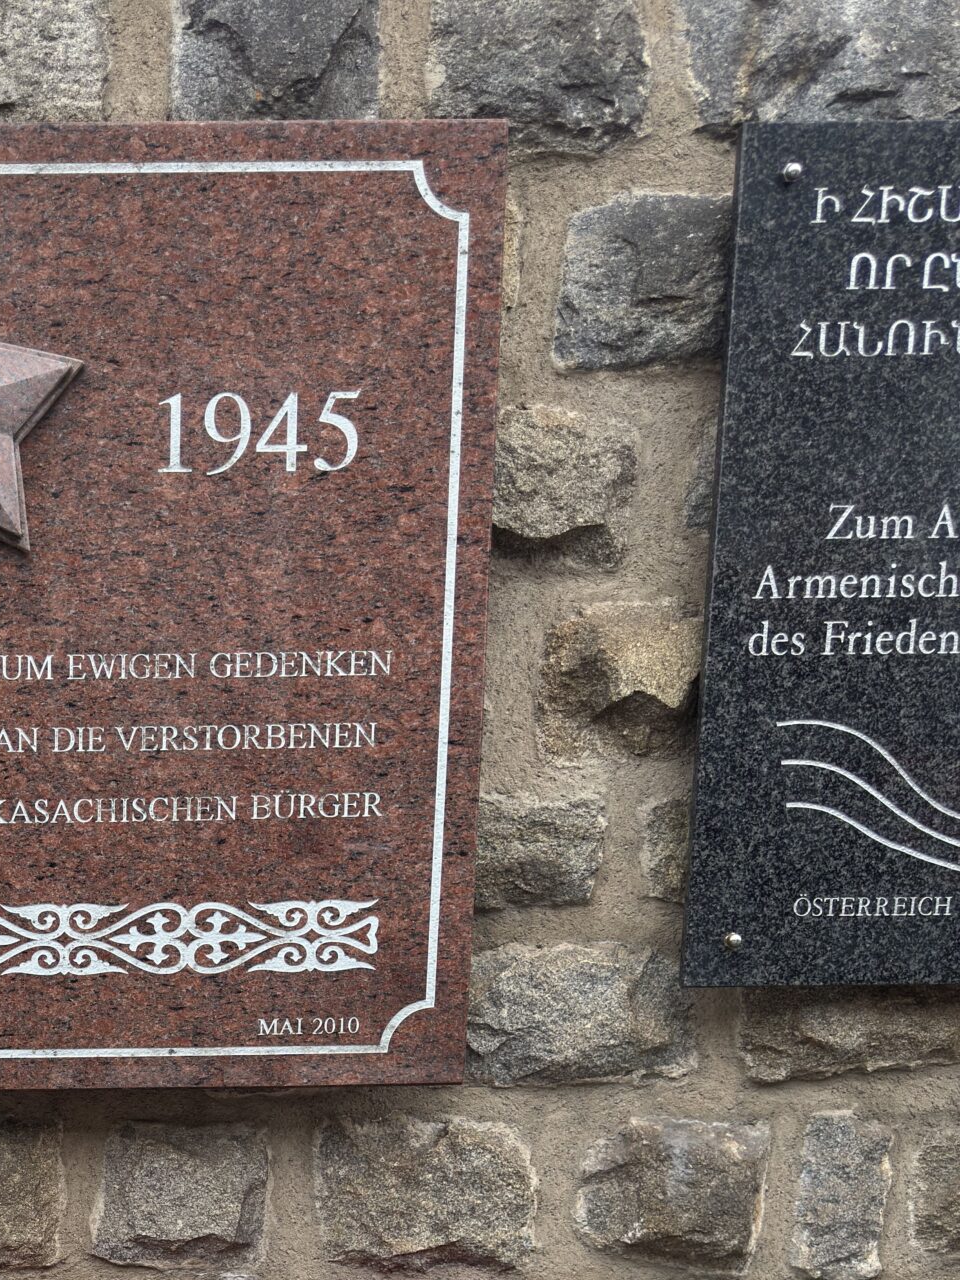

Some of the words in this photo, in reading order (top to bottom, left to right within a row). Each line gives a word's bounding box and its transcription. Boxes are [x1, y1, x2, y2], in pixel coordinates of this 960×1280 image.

[158, 387, 362, 477] 1945
[825, 503, 914, 540] Zum
[752, 561, 960, 600] Armenisch
[748, 620, 806, 656] des
[820, 618, 960, 656] Frieden
[66, 653, 197, 680] EWIGEN
[209, 650, 393, 679] GEDENKEN
[52, 726, 106, 753] DIE
[115, 721, 378, 752] VERSTORBENEN
[250, 791, 383, 821] BÜRGER
[793, 893, 953, 917] ÖSTERREICH
[257, 1018, 304, 1036] MAI
[312, 1016, 360, 1035] 2010
